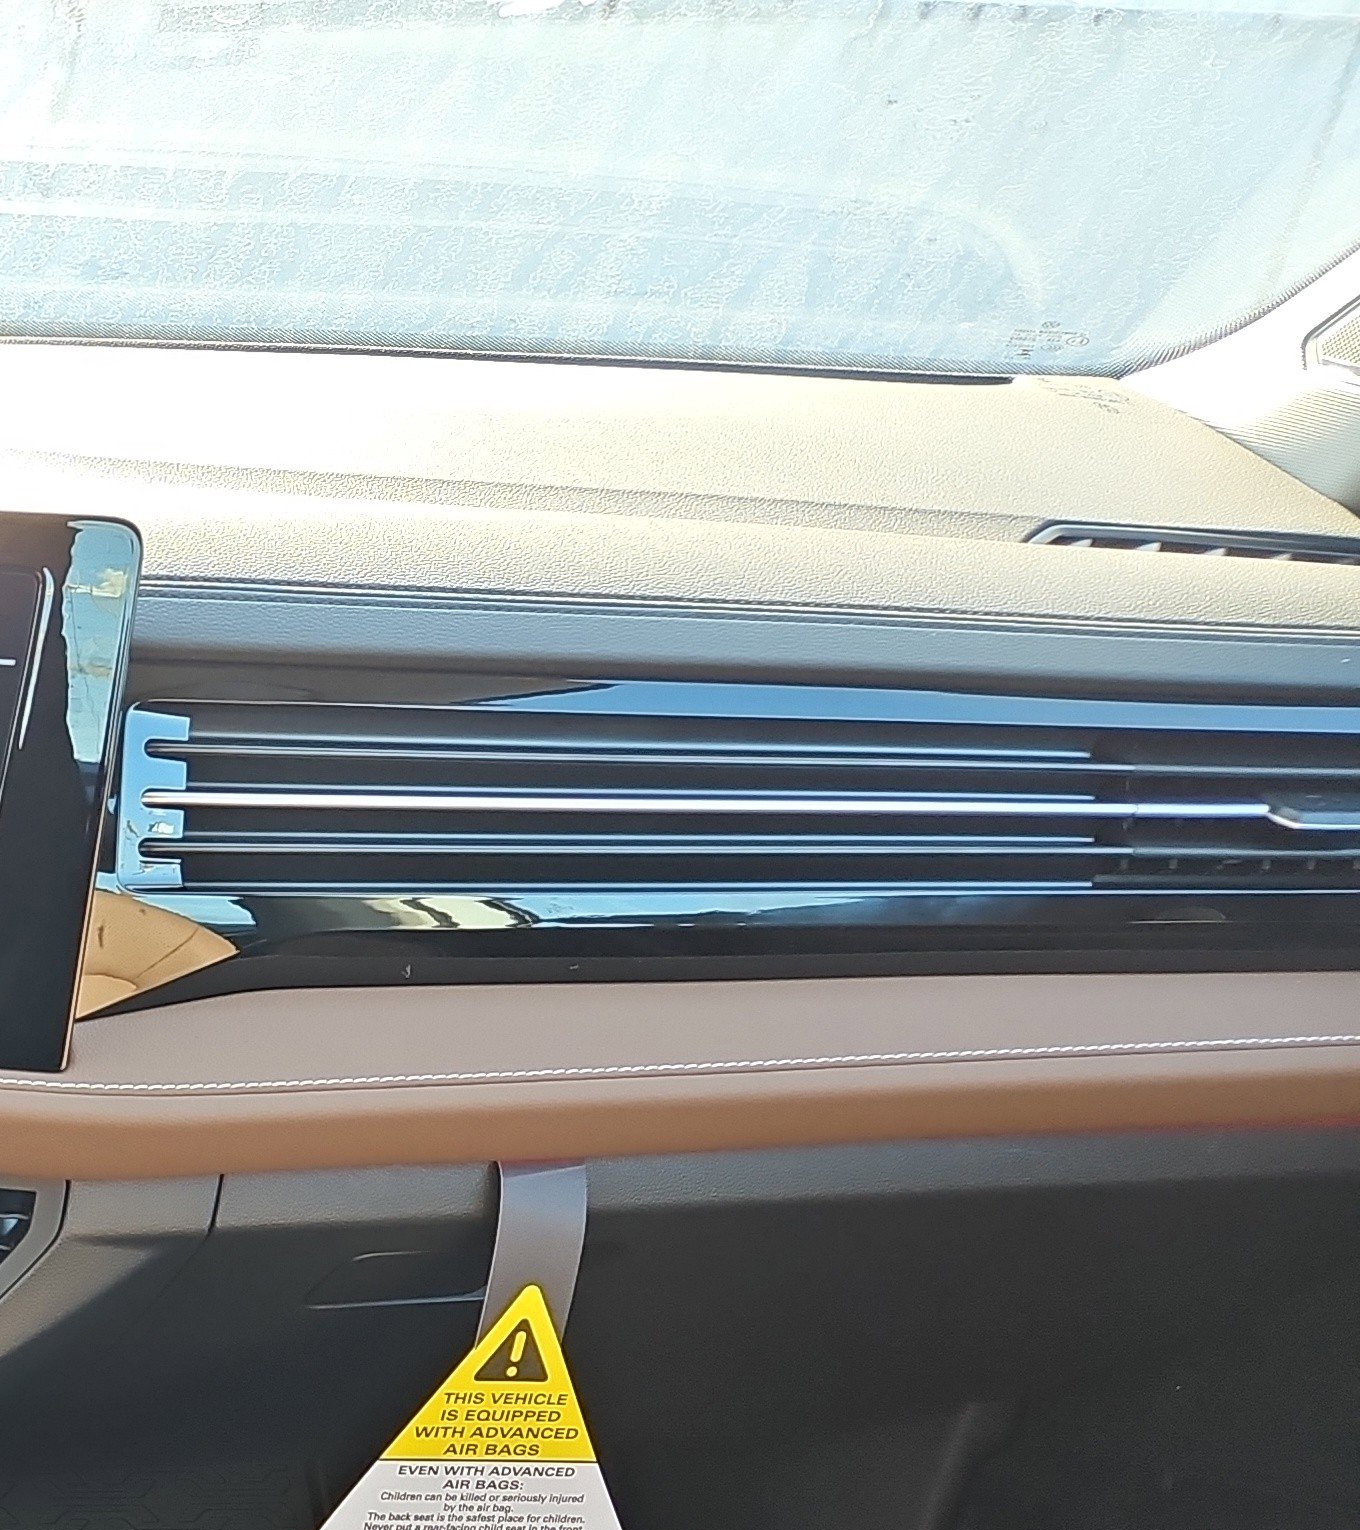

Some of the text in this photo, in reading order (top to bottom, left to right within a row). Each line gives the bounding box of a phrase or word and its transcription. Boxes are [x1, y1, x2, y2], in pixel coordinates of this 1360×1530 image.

[445, 1392, 568, 1405] THIS VEHICLE
[440, 1409, 561, 1422] IS EQUIPPED
[415, 1426, 578, 1439] WITH ADVANCED
[442, 1443, 539, 1455] AIR BAGS
[397, 1465, 575, 1476] EVEN WITH ADVANCED
[442, 1479, 523, 1490] AIR BAGS:
[380, 1491, 422, 1500] Children
[424, 1493, 442, 1501] can
[459, 1492, 487, 1502] killed
[501, 1492, 547, 1504] seriously
[548, 1493, 584, 1504] injured
[443, 1502, 513, 1514] by the air bag.
[367, 1511, 386, 1521] The
[388, 1511, 411, 1521] back
[413, 1513, 434, 1521] seat
[447, 1512, 463, 1521] the
[465, 1513, 495, 1522] safest
[496, 1512, 524, 1523] place
[526, 1513, 541, 1523] for
[542, 1513, 585, 1523] children.
